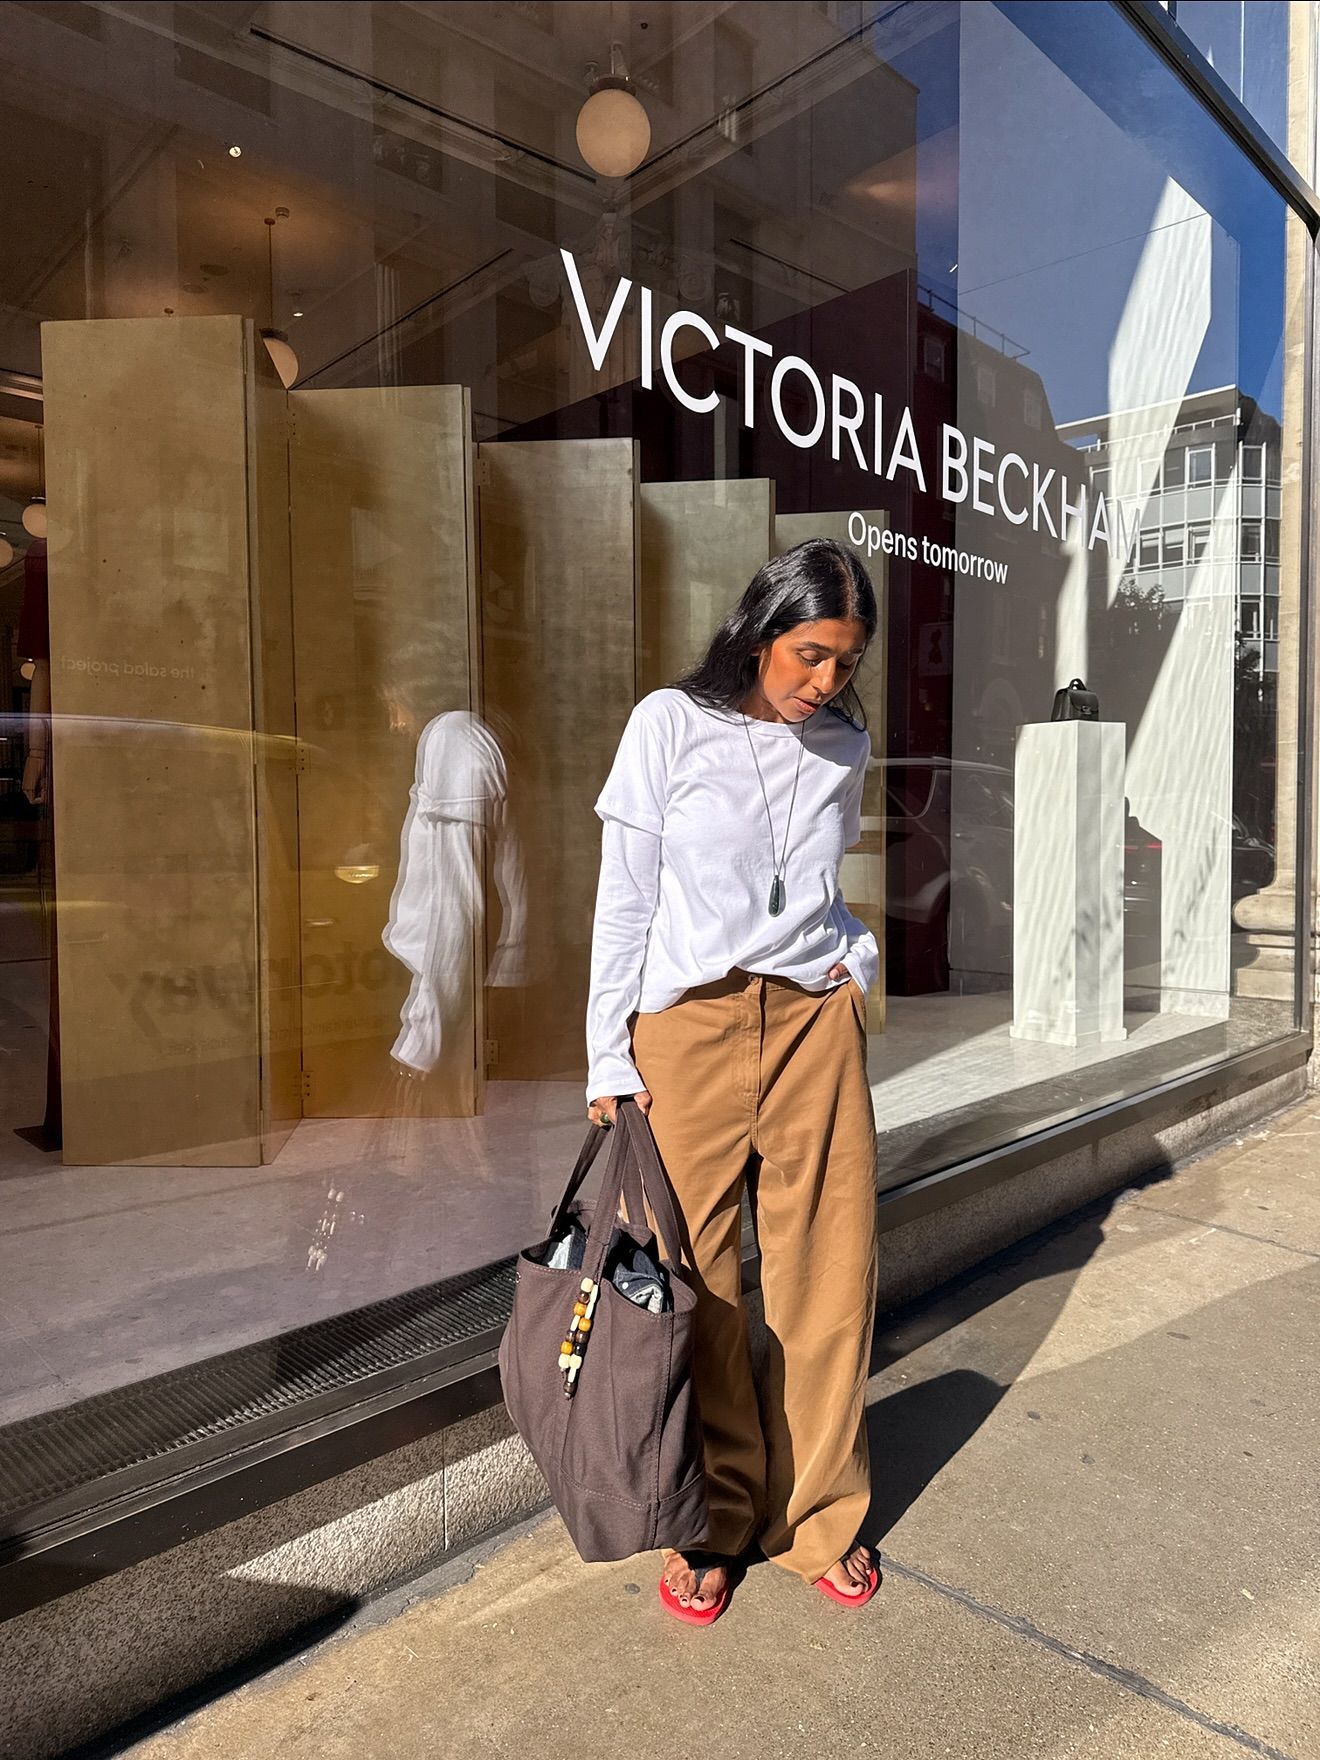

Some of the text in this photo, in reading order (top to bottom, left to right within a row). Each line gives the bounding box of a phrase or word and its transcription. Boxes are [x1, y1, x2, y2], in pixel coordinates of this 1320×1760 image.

[559, 248, 1141, 566] VICTORIA BECKHAM
[848, 511, 1009, 585] Opens tomorrow
